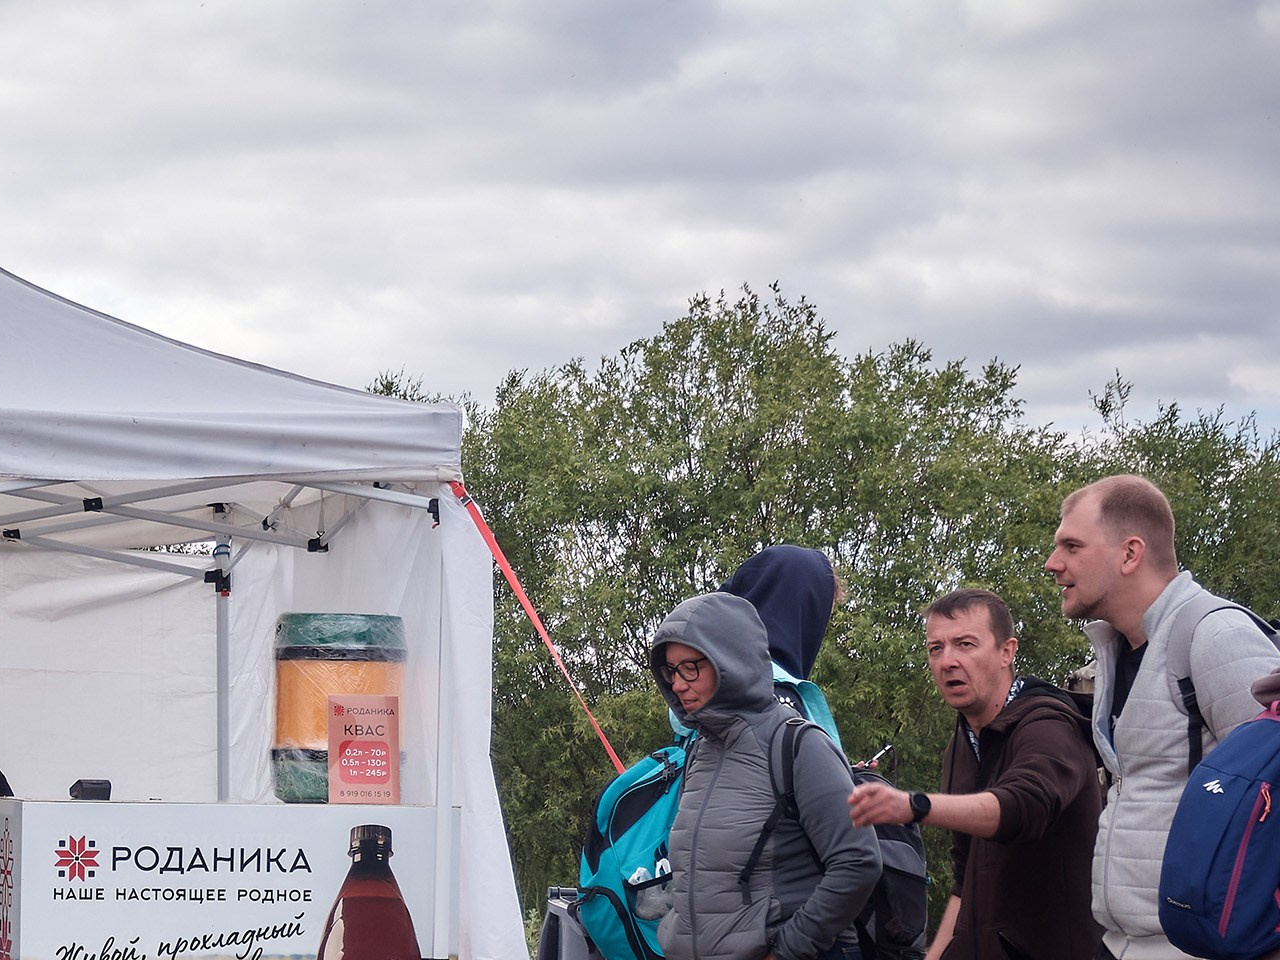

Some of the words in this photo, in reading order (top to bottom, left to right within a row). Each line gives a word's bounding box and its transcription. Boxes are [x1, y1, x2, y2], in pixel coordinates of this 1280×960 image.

[347, 707, 395, 715] РОДАНИКА
[344, 724, 385, 736] КВАС
[111, 845, 313, 875] РОДАНИКА
[53, 887, 105, 901] НАШЕ
[115, 887, 227, 904] НАСТОЯЩЕЕ
[237, 888, 313, 904] РОДНОЕ
